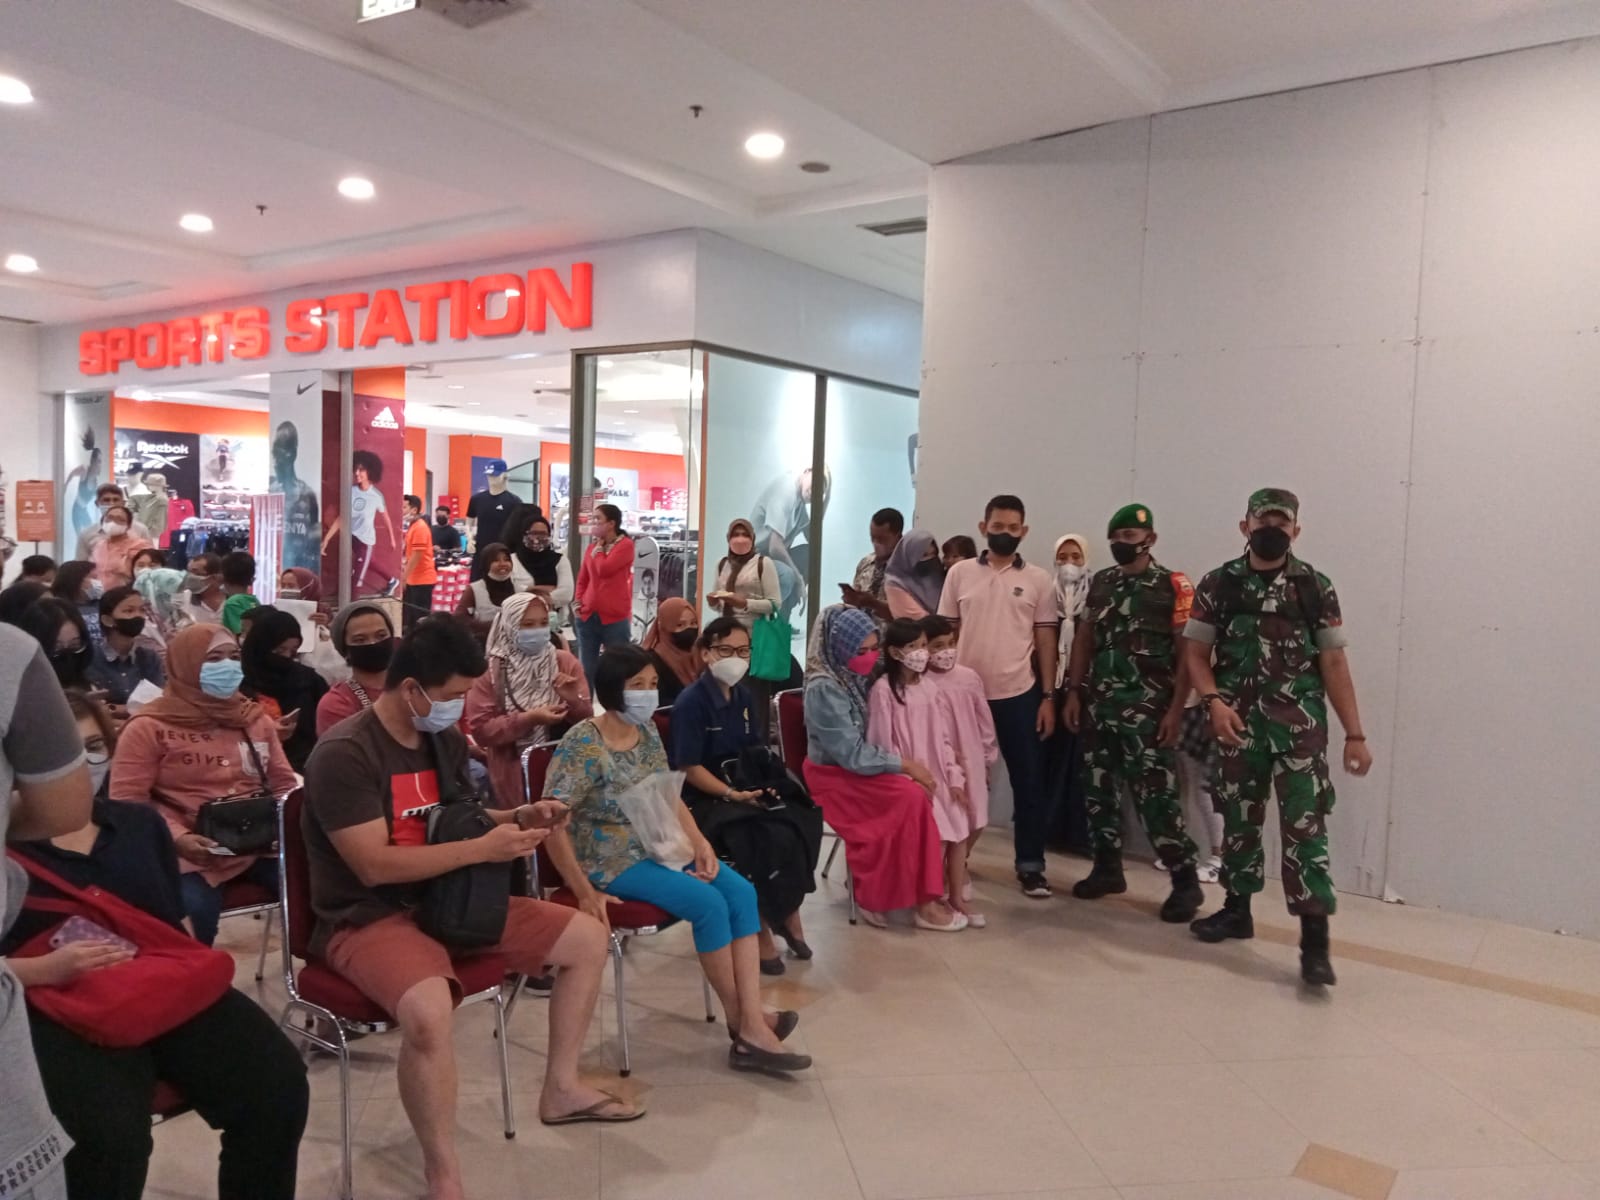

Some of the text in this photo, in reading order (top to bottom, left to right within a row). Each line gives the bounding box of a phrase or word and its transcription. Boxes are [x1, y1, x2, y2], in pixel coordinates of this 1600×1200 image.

[79, 261, 593, 375] SPORTS STATION
[136, 440, 189, 454] Reebok
[155, 729, 214, 743] NEVER
[183, 752, 229, 767] GIVE
